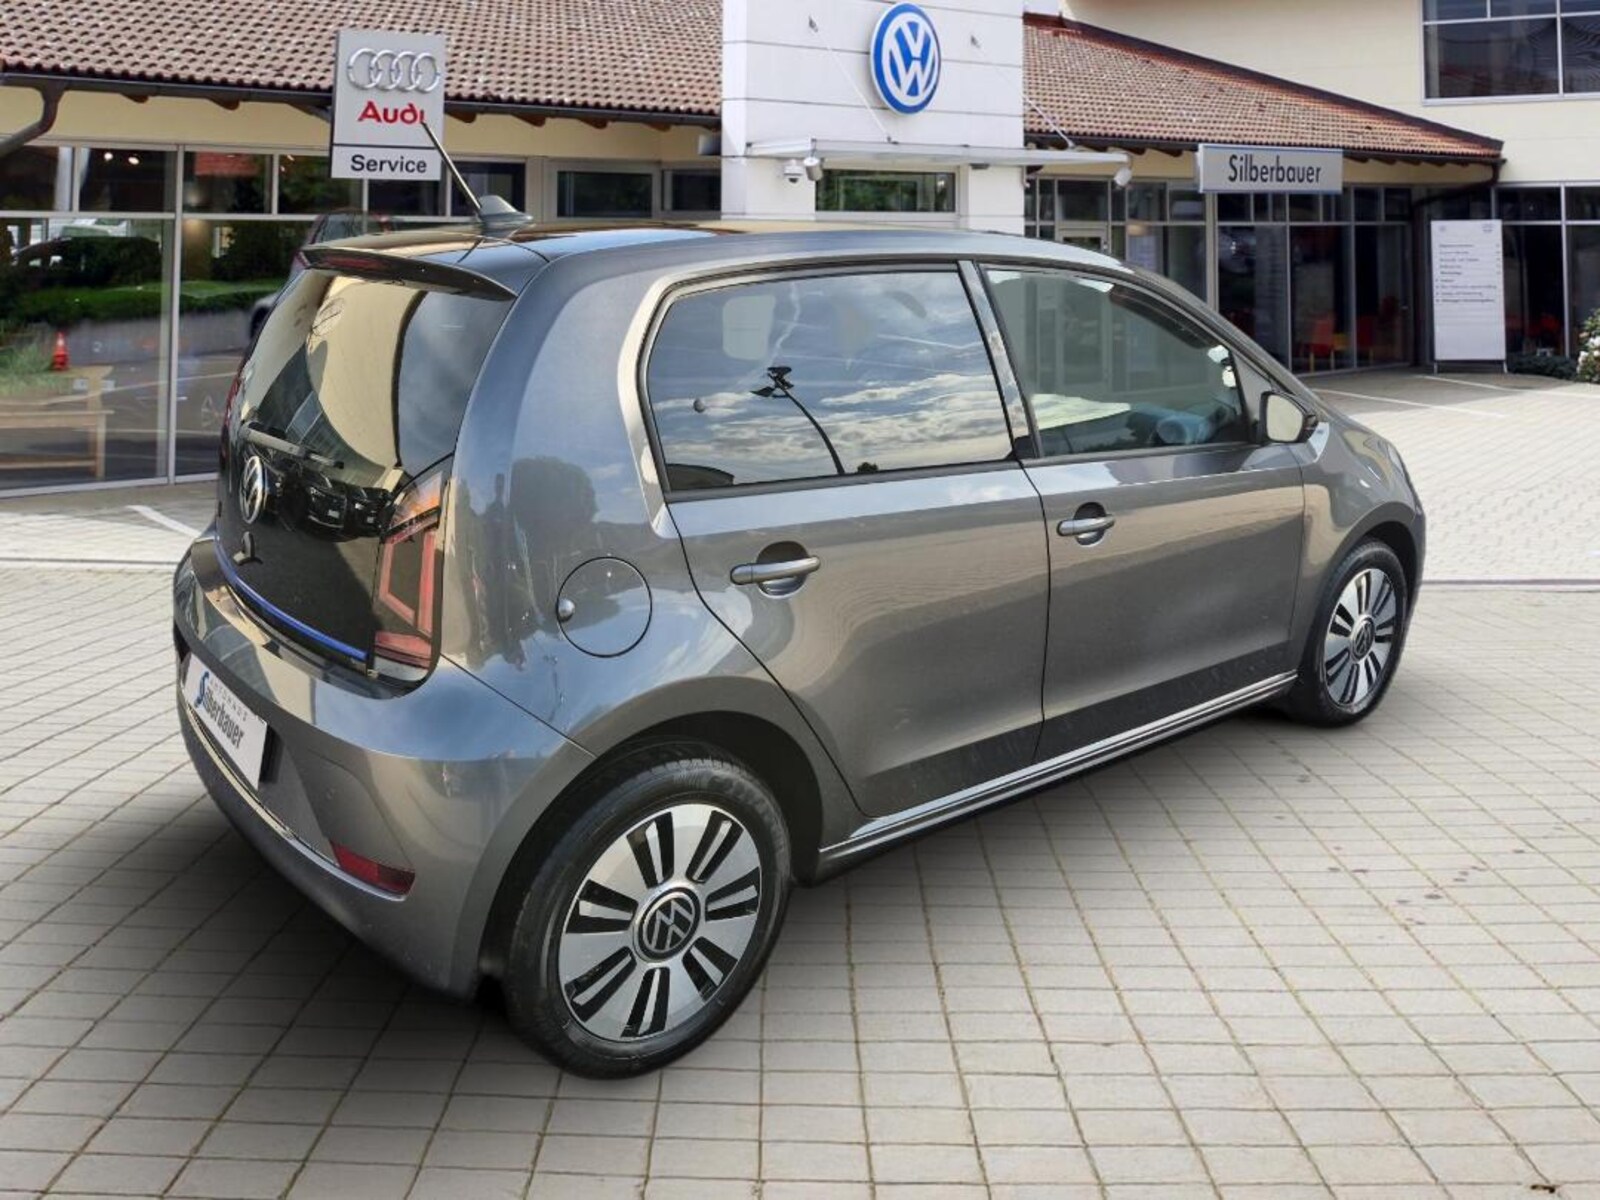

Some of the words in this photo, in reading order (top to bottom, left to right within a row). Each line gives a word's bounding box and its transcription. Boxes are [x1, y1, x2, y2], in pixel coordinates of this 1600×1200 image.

[357, 100, 425, 125] Audi
[350, 154, 428, 174] Service
[1228, 153, 1322, 184] Silberbauer
